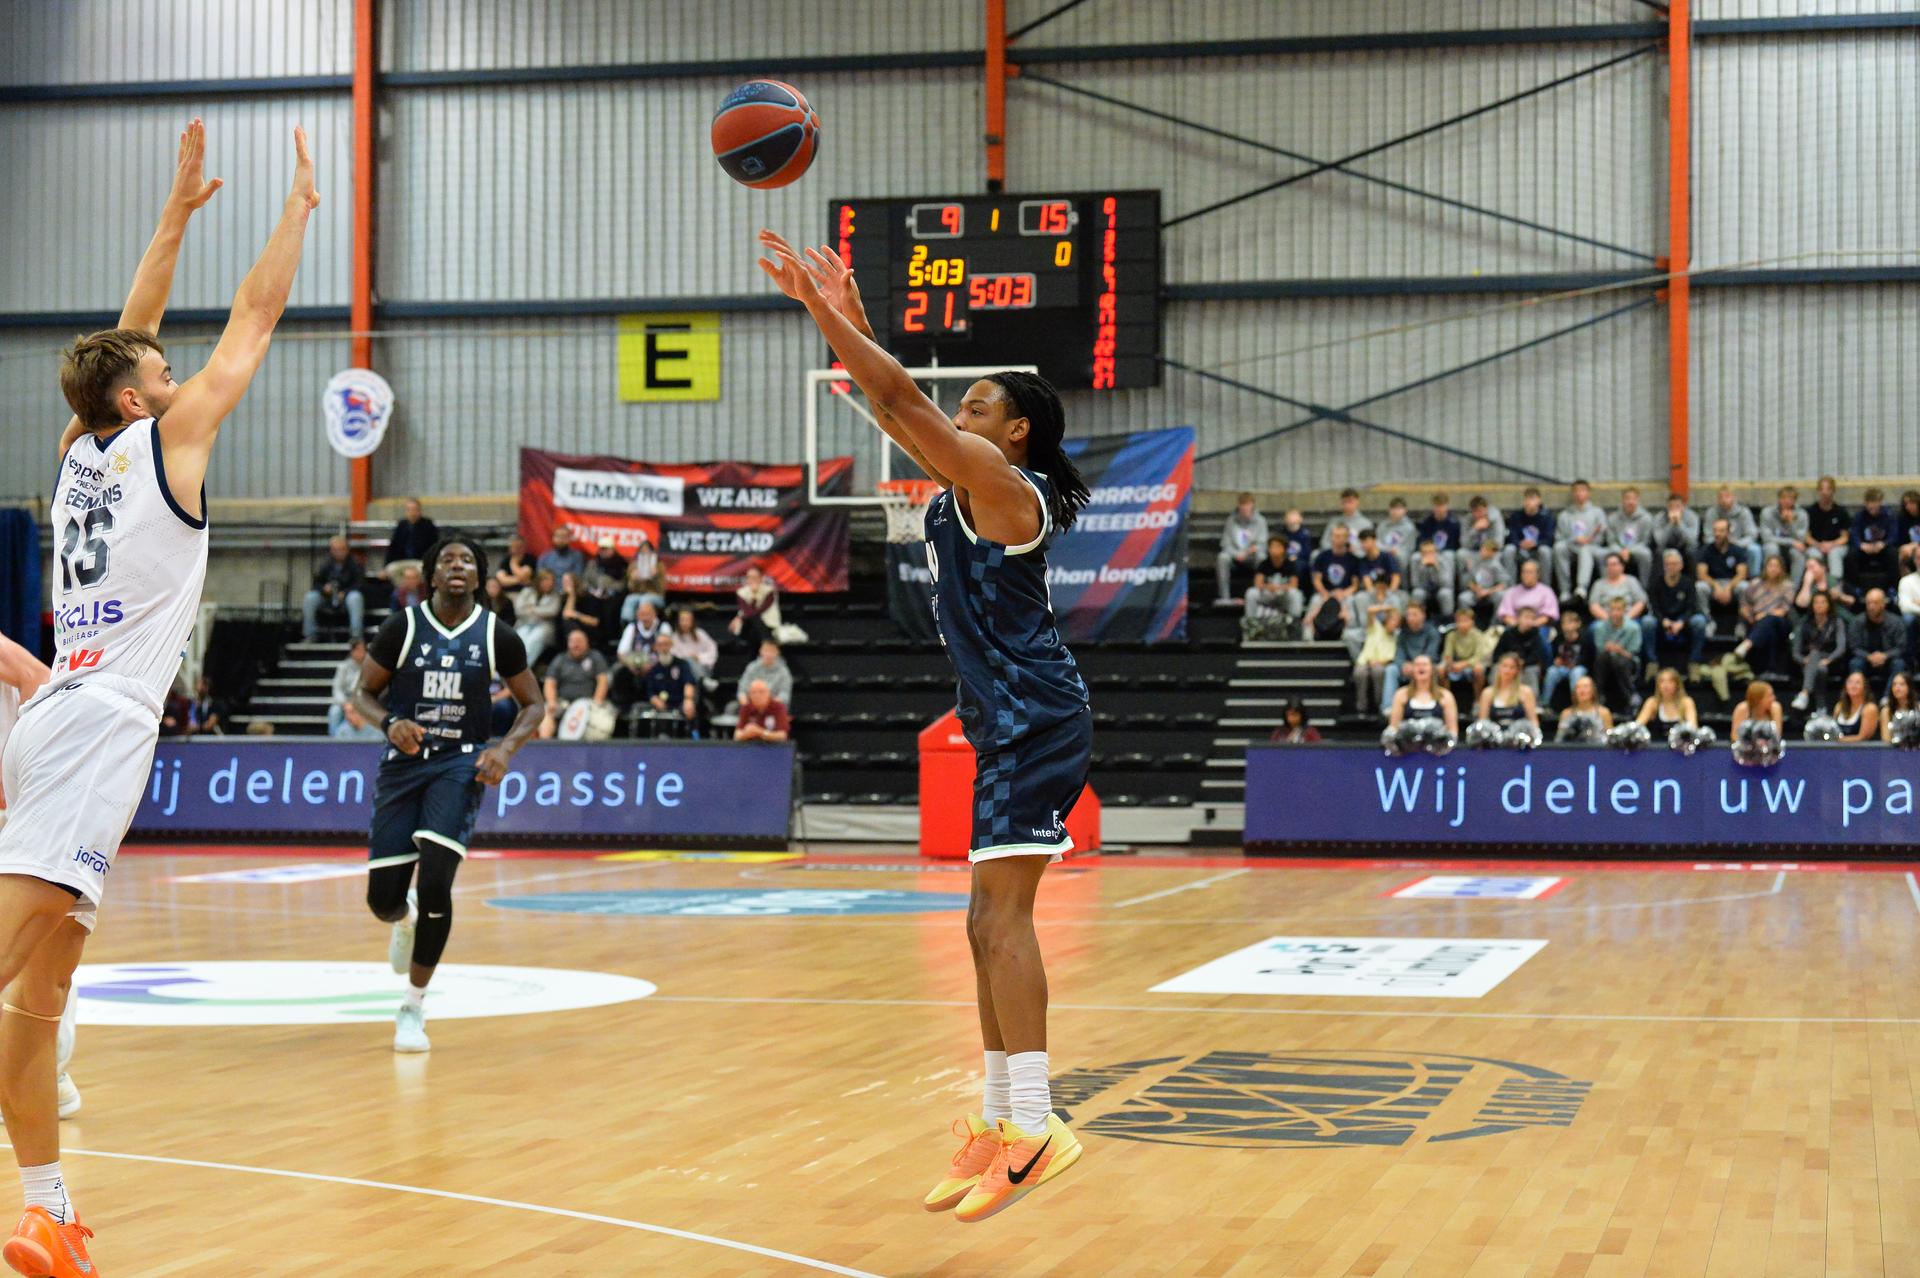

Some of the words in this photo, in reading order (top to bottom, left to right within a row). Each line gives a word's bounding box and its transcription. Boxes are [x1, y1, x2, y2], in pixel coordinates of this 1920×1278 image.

[941, 206, 960, 235] 9
[990, 208, 1000, 232] 1
[1039, 203, 1068, 234] 15
[1055, 241, 1072, 267] 0
[908, 259, 964, 287] 5:03
[968, 276, 1032, 307] 5:03
[645, 324, 692, 388] E
[65, 484, 122, 510] EEMNS
[569, 481, 671, 503] LIMBURG
[697, 488, 733, 507] WE
[734, 488, 779, 508] ARE
[668, 531, 706, 551] WE
[706, 532, 775, 552] STAND
[422, 671, 464, 700] BXL
[152, 759, 181, 816] ij
[209, 757, 364, 804] delen
[498, 762, 684, 817] passie
[1375, 766, 1466, 828] Wij
[1501, 765, 1682, 815] delen
[1720, 778, 1806, 814] uw
